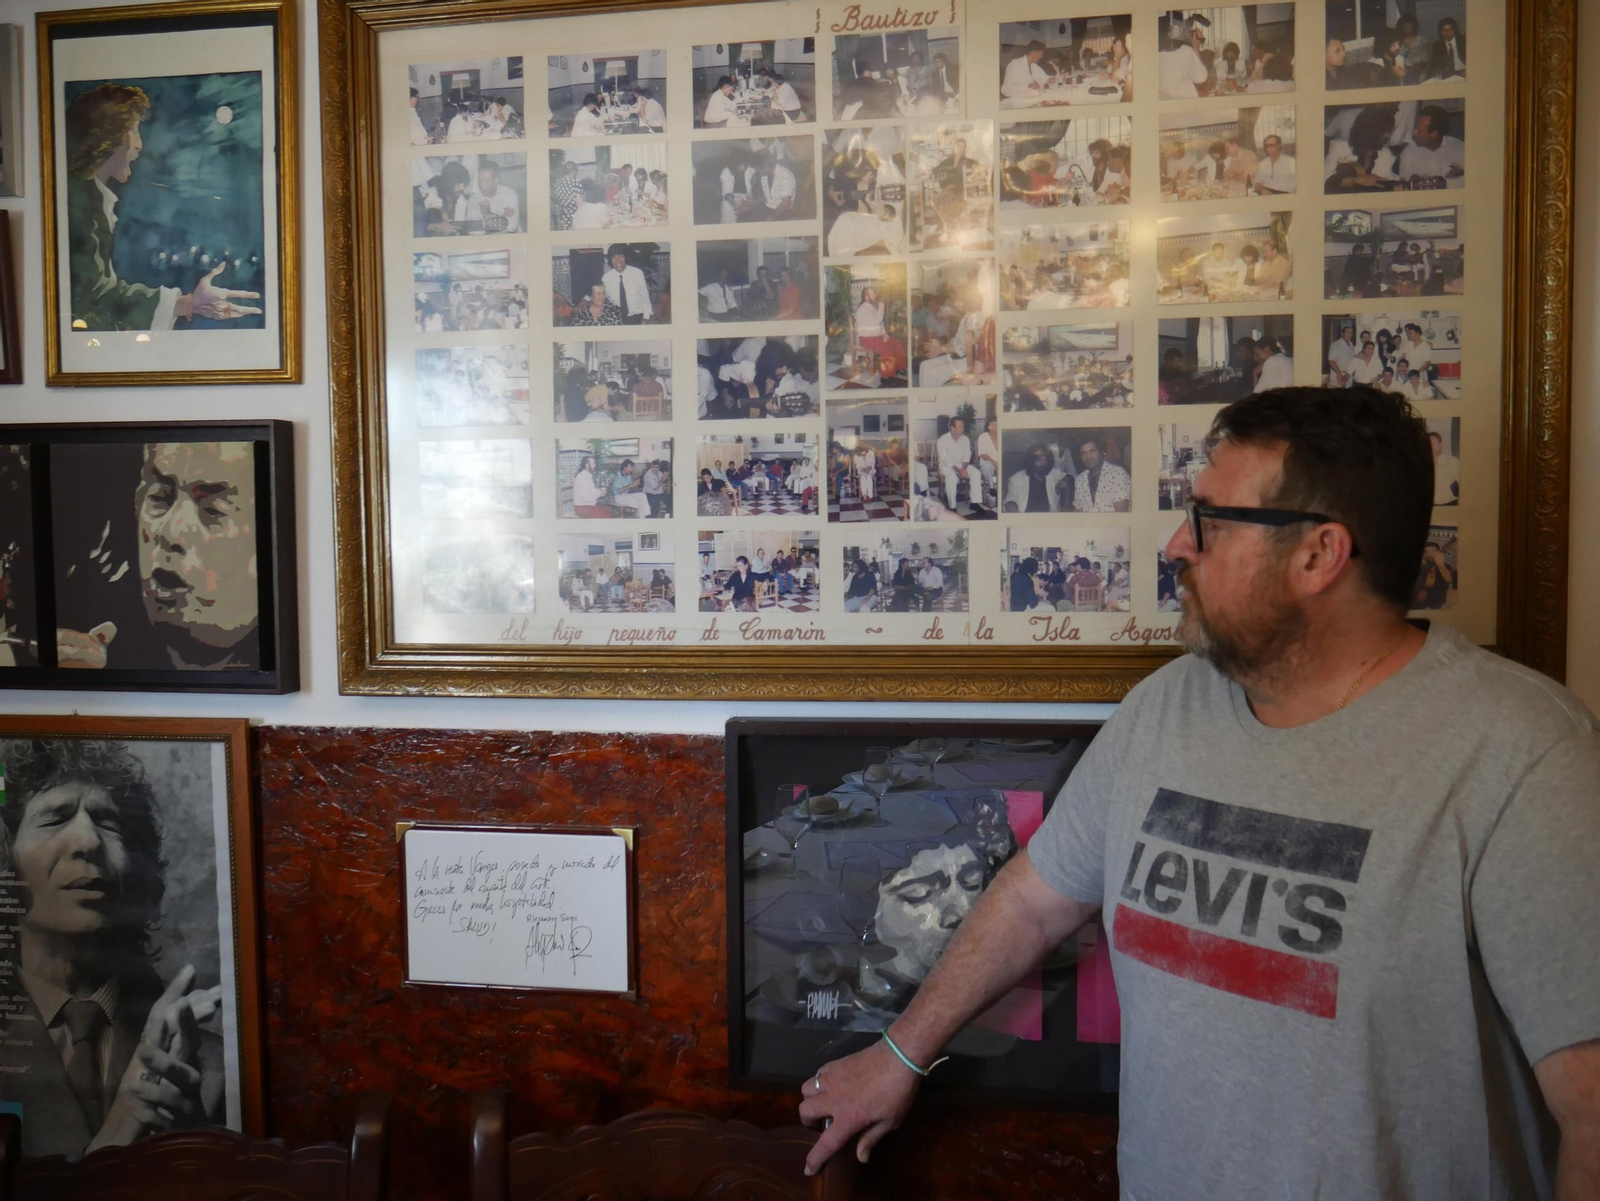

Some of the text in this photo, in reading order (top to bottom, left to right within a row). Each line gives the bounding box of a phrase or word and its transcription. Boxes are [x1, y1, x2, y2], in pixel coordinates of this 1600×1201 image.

[831, 4, 939, 33] Bautizo
[498, 617, 529, 642] del
[552, 617, 583, 646] hijo
[606, 626, 677, 646] pequeño
[699, 616, 720, 642] de
[739, 615, 826, 642] Camarón
[921, 616, 944, 641] de
[974, 616, 995, 641] la
